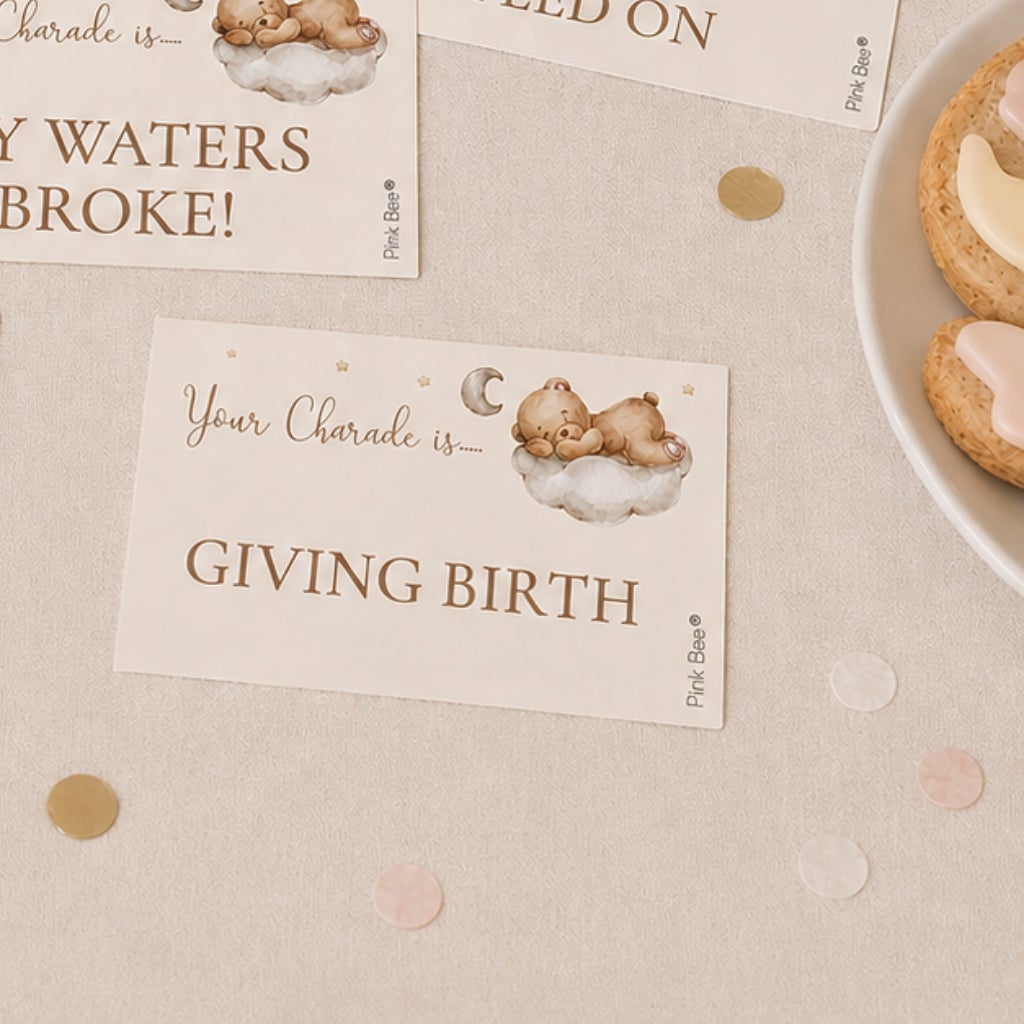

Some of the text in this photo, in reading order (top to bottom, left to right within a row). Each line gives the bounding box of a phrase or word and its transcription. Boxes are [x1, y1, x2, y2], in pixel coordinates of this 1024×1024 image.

[844, 79, 866, 112] Pink
[43, 118, 310, 173] WATERS
[382, 226, 400, 260] Pink
[183, 383, 271, 448] Your
[286, 394, 421, 448] Charade
[186, 538, 640, 627] GIVING BIRTH
[685, 669, 705, 708] Pink
